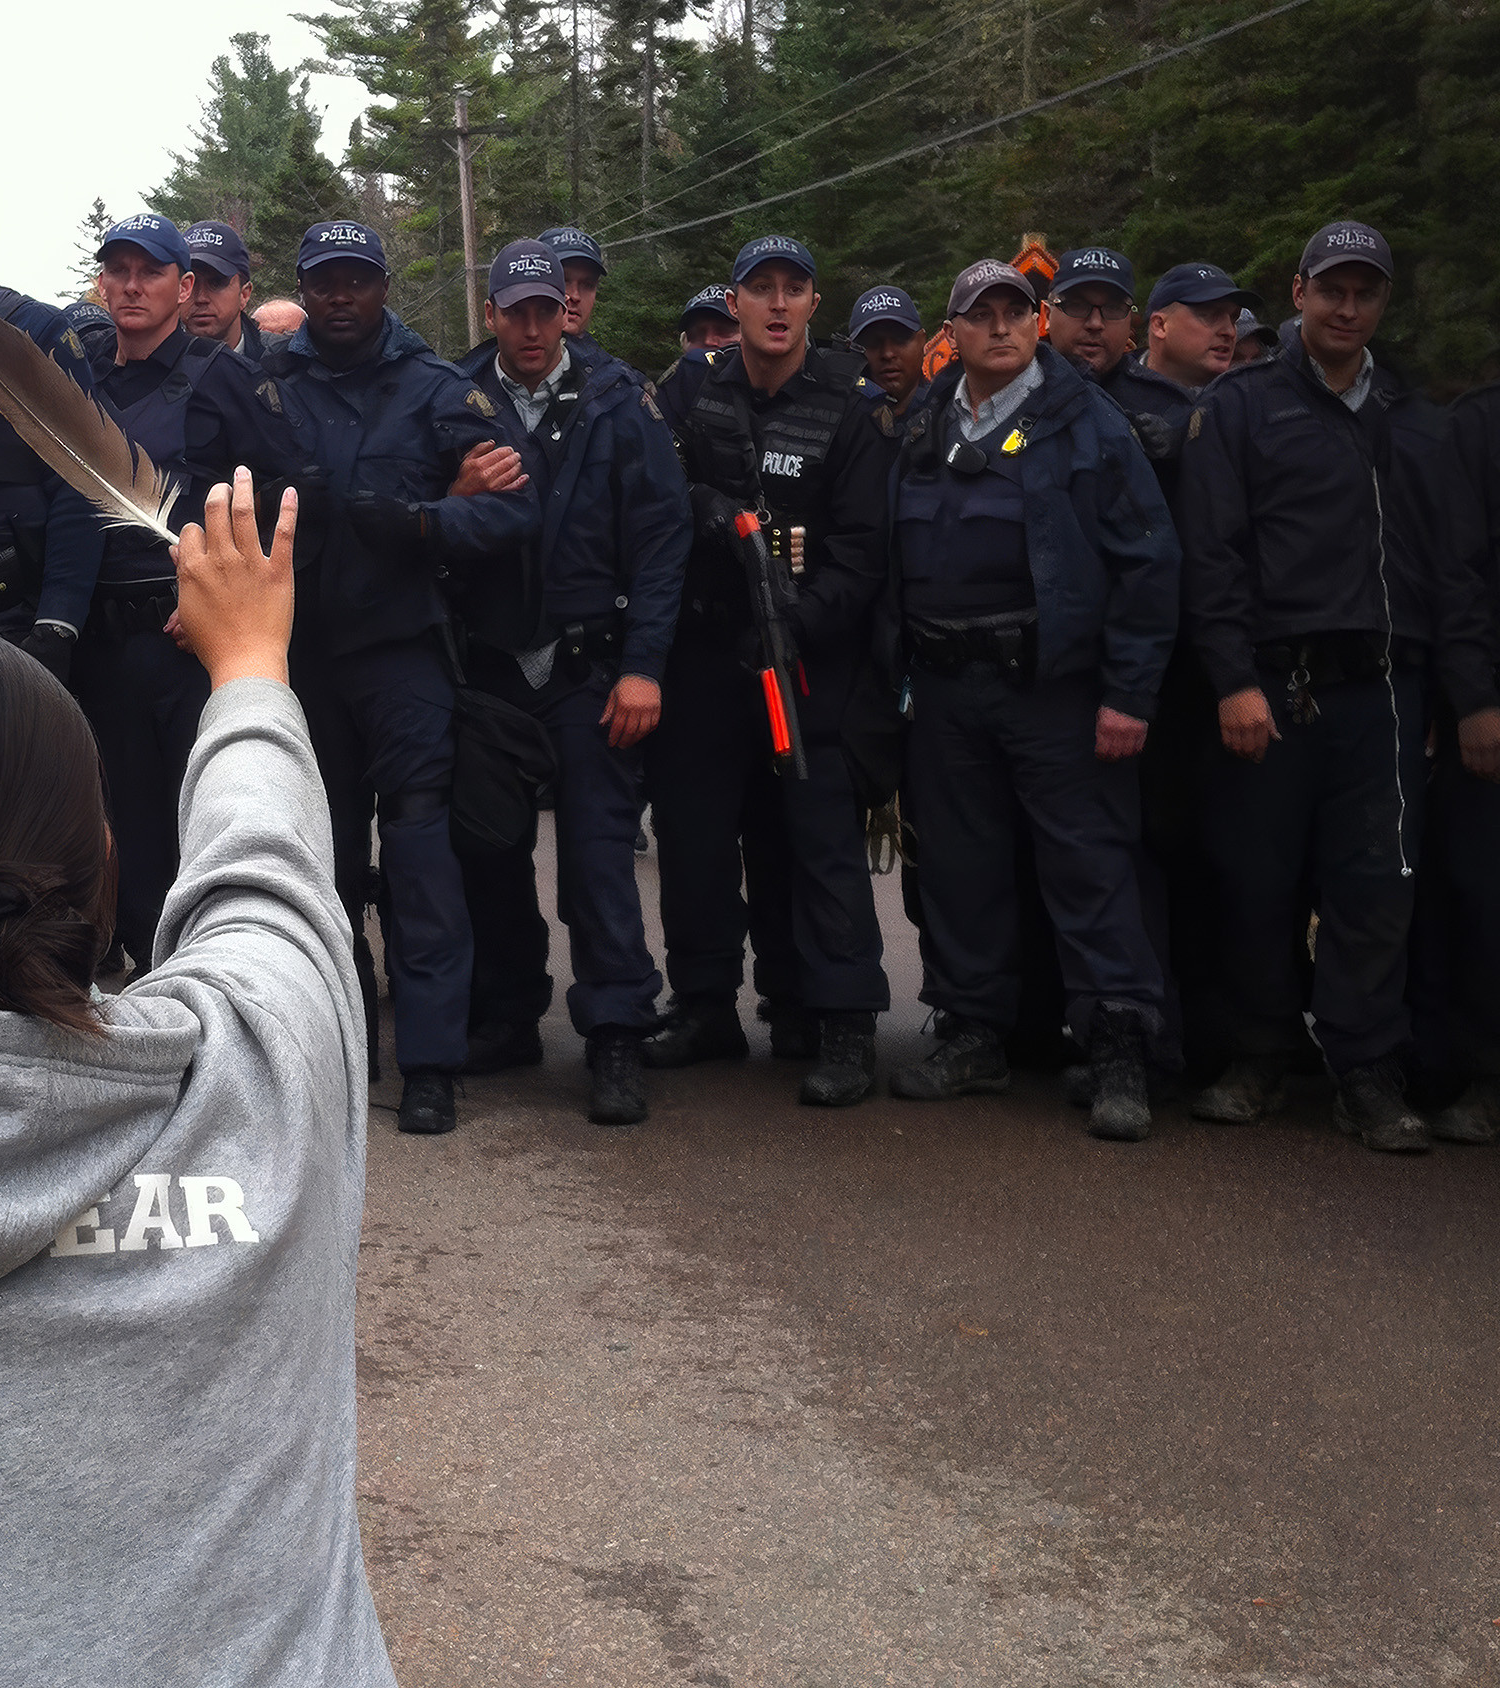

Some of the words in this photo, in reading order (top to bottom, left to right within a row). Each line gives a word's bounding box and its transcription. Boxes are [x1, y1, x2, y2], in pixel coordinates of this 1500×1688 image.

[319, 229, 367, 244] POLICE
[1327, 232, 1377, 249] POLICE
[1073, 251, 1120, 269] POLICE
[861, 293, 901, 313] POLICE
[762, 451, 803, 478] POLICE
